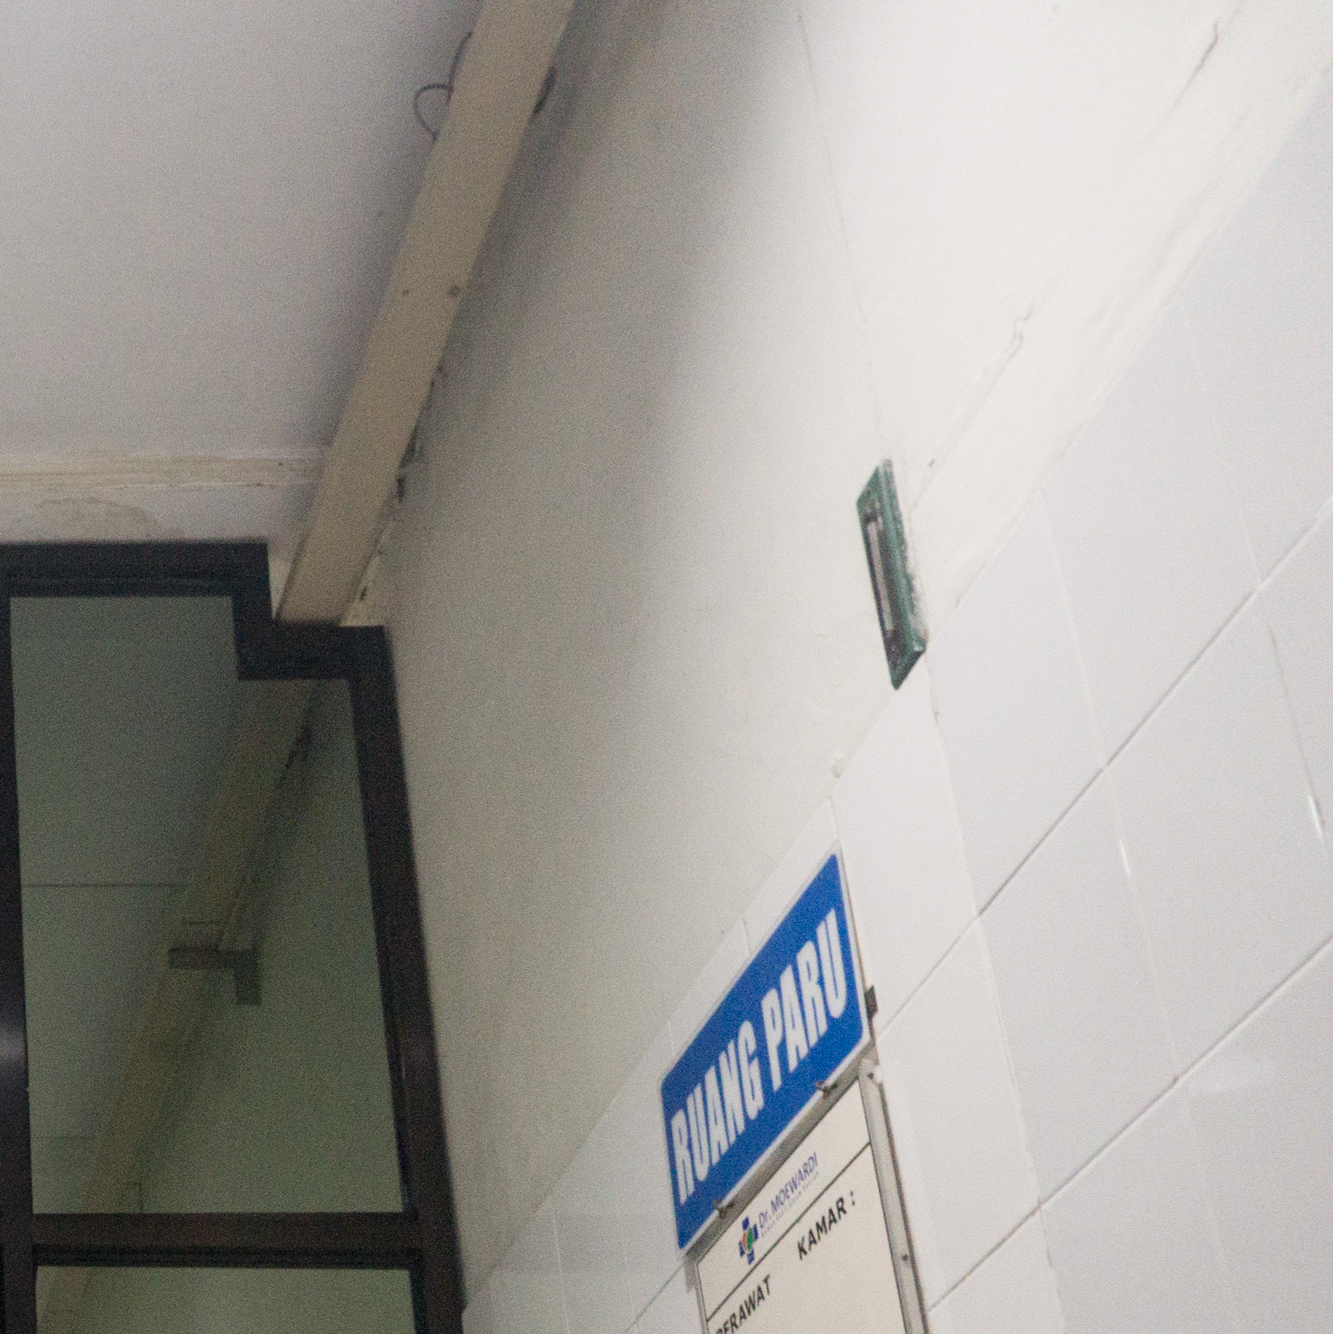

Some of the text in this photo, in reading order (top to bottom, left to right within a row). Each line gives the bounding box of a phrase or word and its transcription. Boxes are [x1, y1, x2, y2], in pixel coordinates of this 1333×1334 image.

[671, 1020, 765, 1206] RUANG
[761, 907, 848, 1093] PARU
[770, 1151, 819, 1212] MOEWARDI
[797, 1196, 848, 1261] KAMAR
